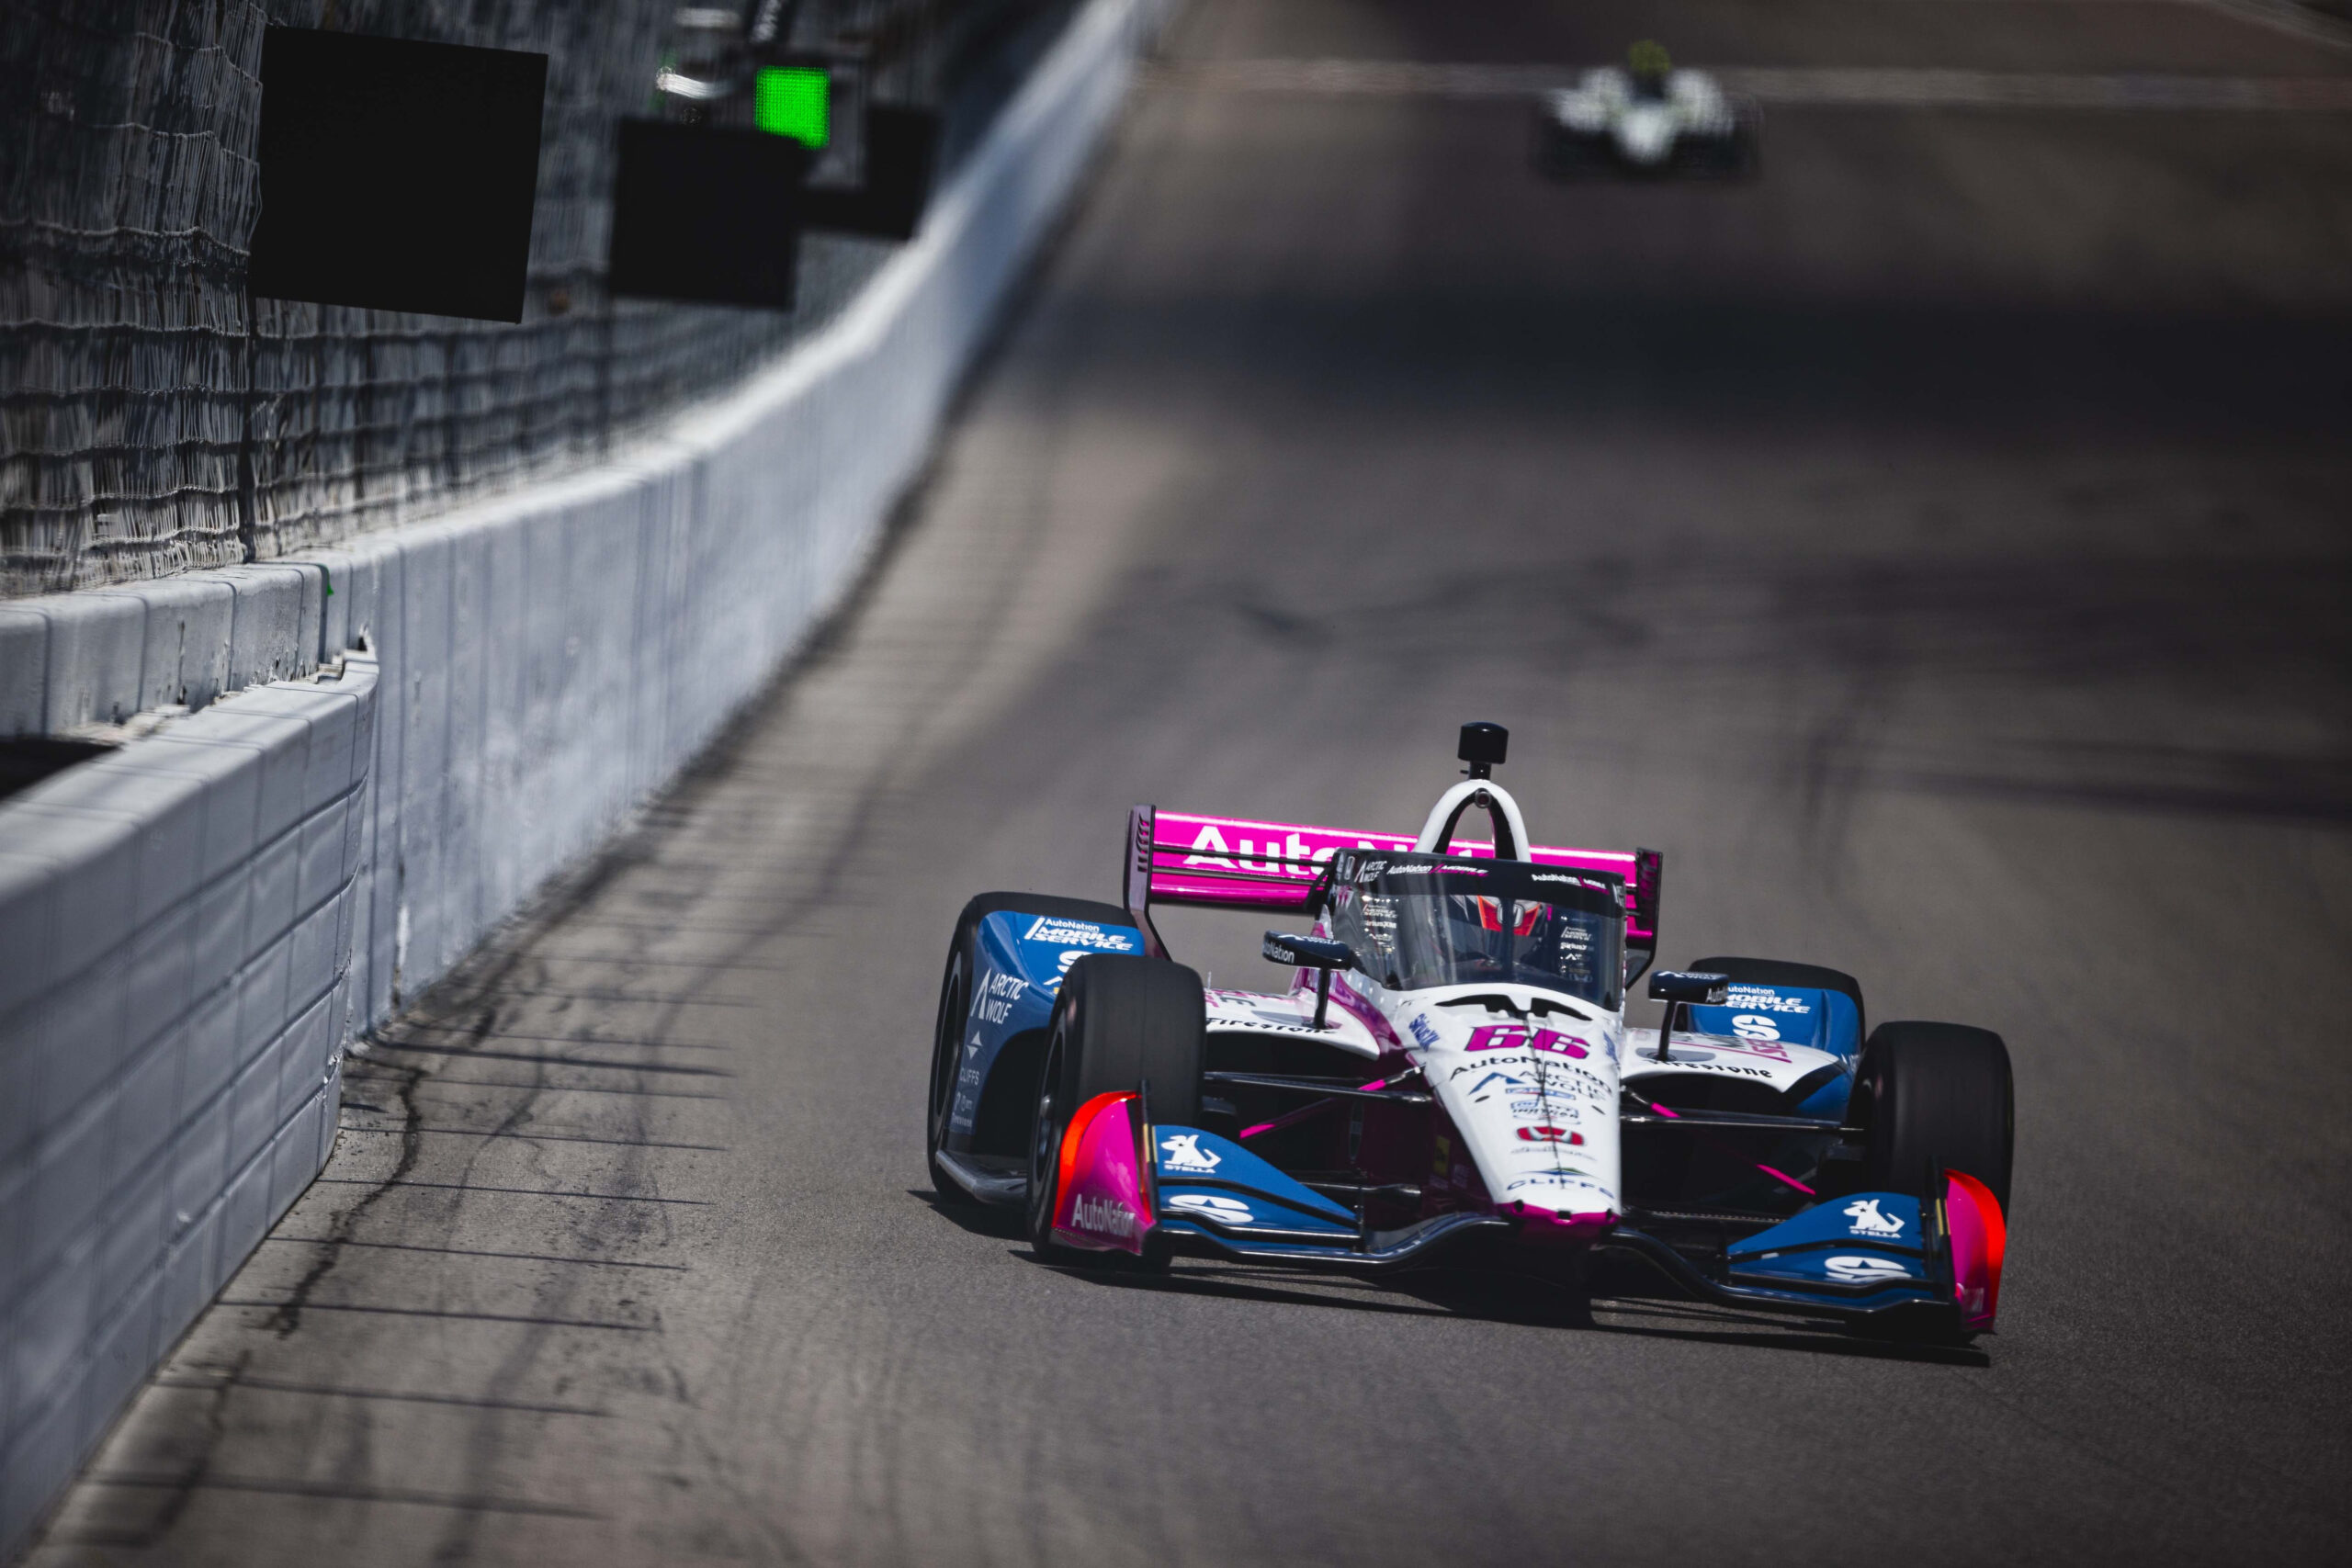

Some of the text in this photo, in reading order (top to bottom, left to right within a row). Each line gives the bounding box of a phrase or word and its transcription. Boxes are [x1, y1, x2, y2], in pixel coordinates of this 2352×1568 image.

[1045, 918, 1100, 932] AutoNation
[1039, 928, 1126, 942] MOBILE
[1034, 936, 1134, 951] SERVICE
[989, 972, 1030, 1001] ARCTIC
[1727, 986, 1775, 996] utoNation
[986, 1001, 1012, 1026] WOLF
[1725, 1001, 1812, 1014] ERVICE
[1464, 1024, 1590, 1060] 66
[1449, 1055, 1612, 1096] AutoNation
[1163, 1164, 1216, 1174] STELLA
[1506, 1178, 1615, 1200] CLIFFS
[1849, 1229, 1902, 1239] STELLA
